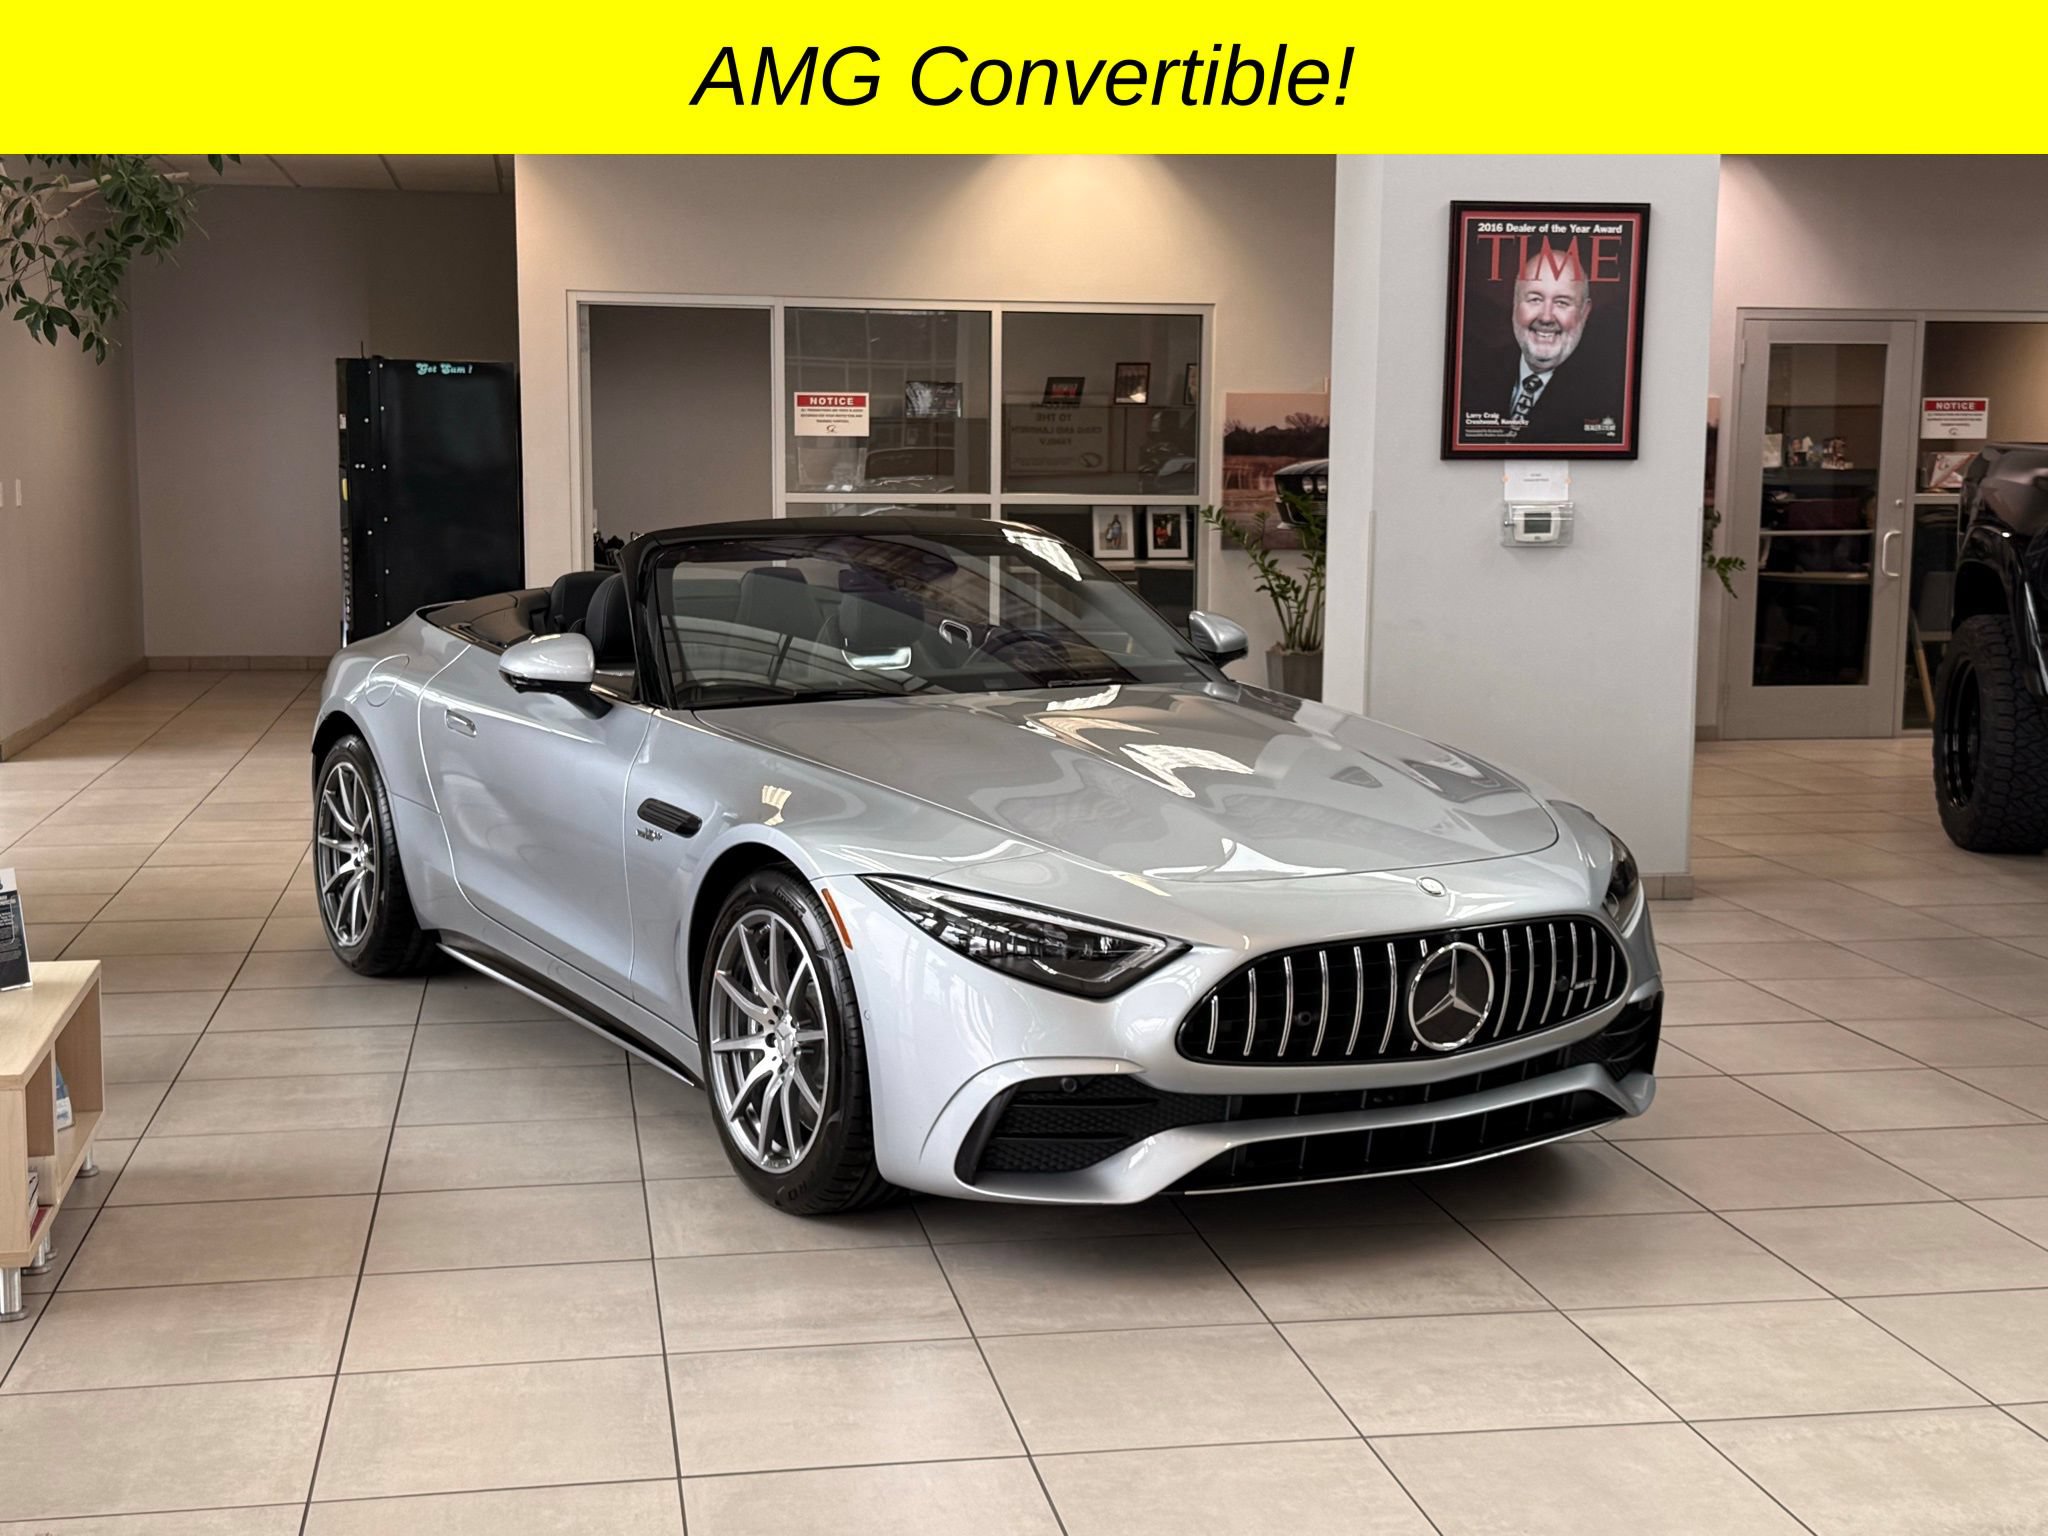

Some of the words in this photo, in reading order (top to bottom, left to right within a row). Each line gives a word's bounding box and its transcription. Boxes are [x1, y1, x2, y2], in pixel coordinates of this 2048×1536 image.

[1478, 223, 1503, 233] 2016
[1506, 223, 1536, 233] Dealer
[1539, 223, 1549, 233] of
[1551, 224, 1566, 233] the
[1570, 224, 1590, 234] Year
[1593, 224, 1622, 234] Award
[1477, 234, 1622, 282] TIME
[809, 397, 854, 406] NOTICE
[1935, 402, 1976, 410] NOTICE
